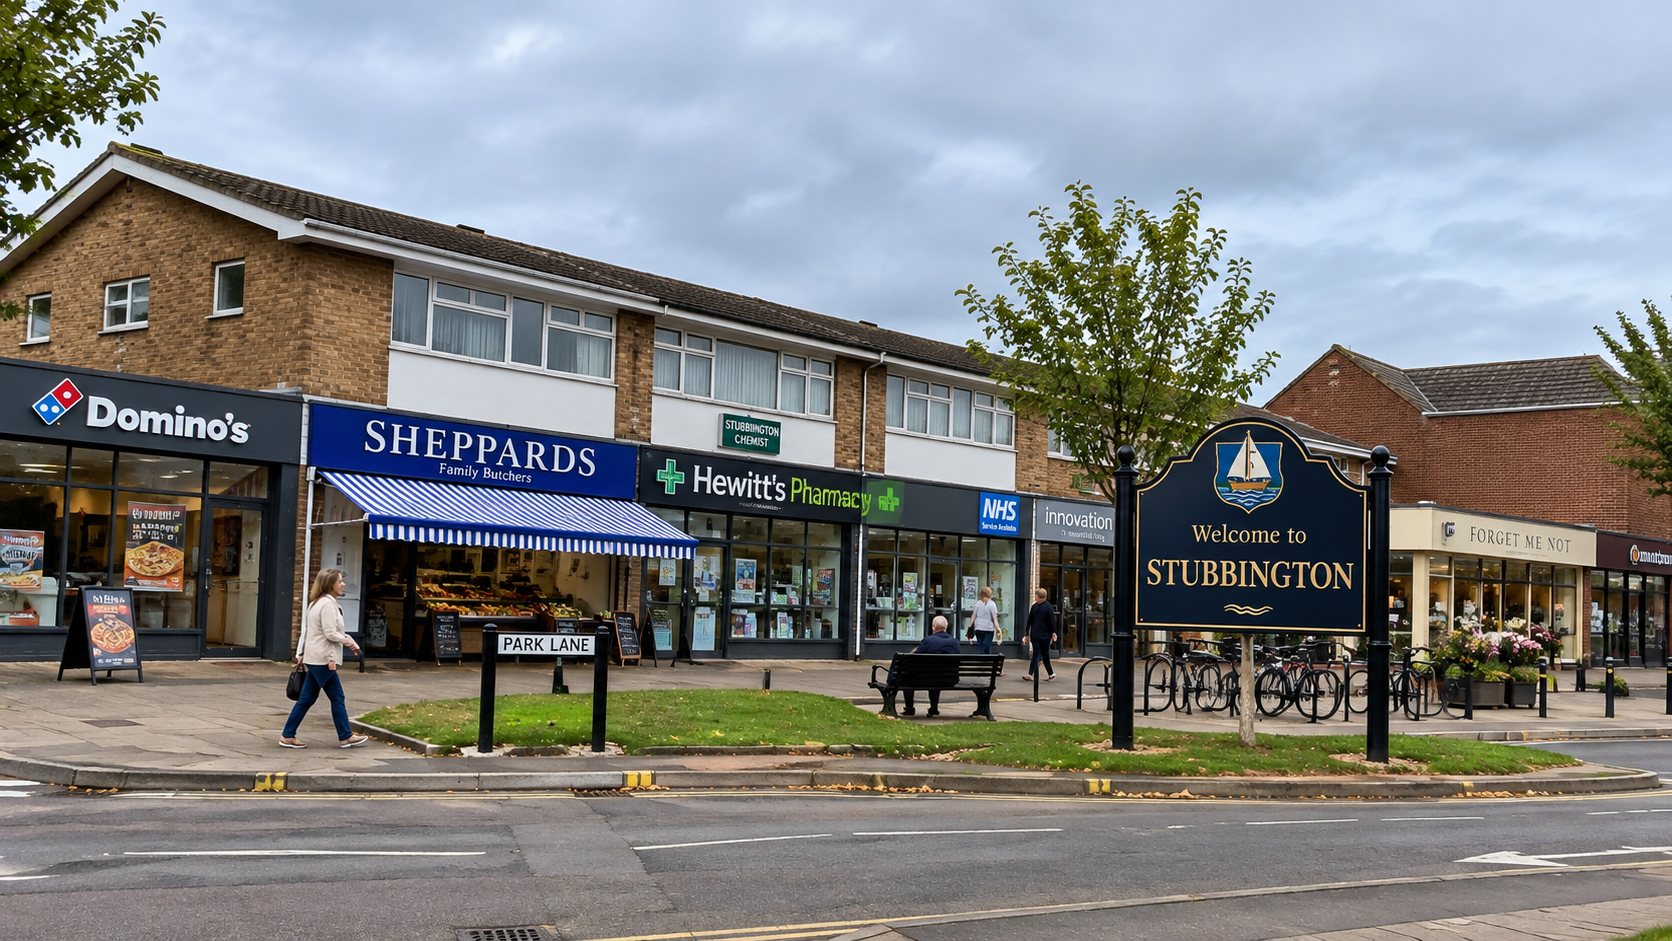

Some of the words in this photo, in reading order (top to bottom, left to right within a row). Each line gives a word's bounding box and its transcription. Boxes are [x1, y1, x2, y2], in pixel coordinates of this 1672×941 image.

[86, 395, 250, 444] Domino's
[364, 419, 597, 478] SHEPPARDS
[439, 462, 480, 480] Family
[483, 466, 533, 484] Butchers
[692, 464, 787, 502] Hewitt's
[790, 477, 872, 517] Pharmacy
[982, 497, 1017, 521] NHS
[1045, 506, 1113, 531] innovation
[1191, 523, 1281, 545] Welcome
[1287, 527, 1307, 545] to
[1470, 526, 1521, 548] FORGET
[1524, 534, 1542, 551] ME
[1547, 536, 1572, 553] NOT
[1146, 558, 1355, 590] STUBBINGTON
[503, 636, 545, 652] PARK
[549, 637, 590, 653] LANE
